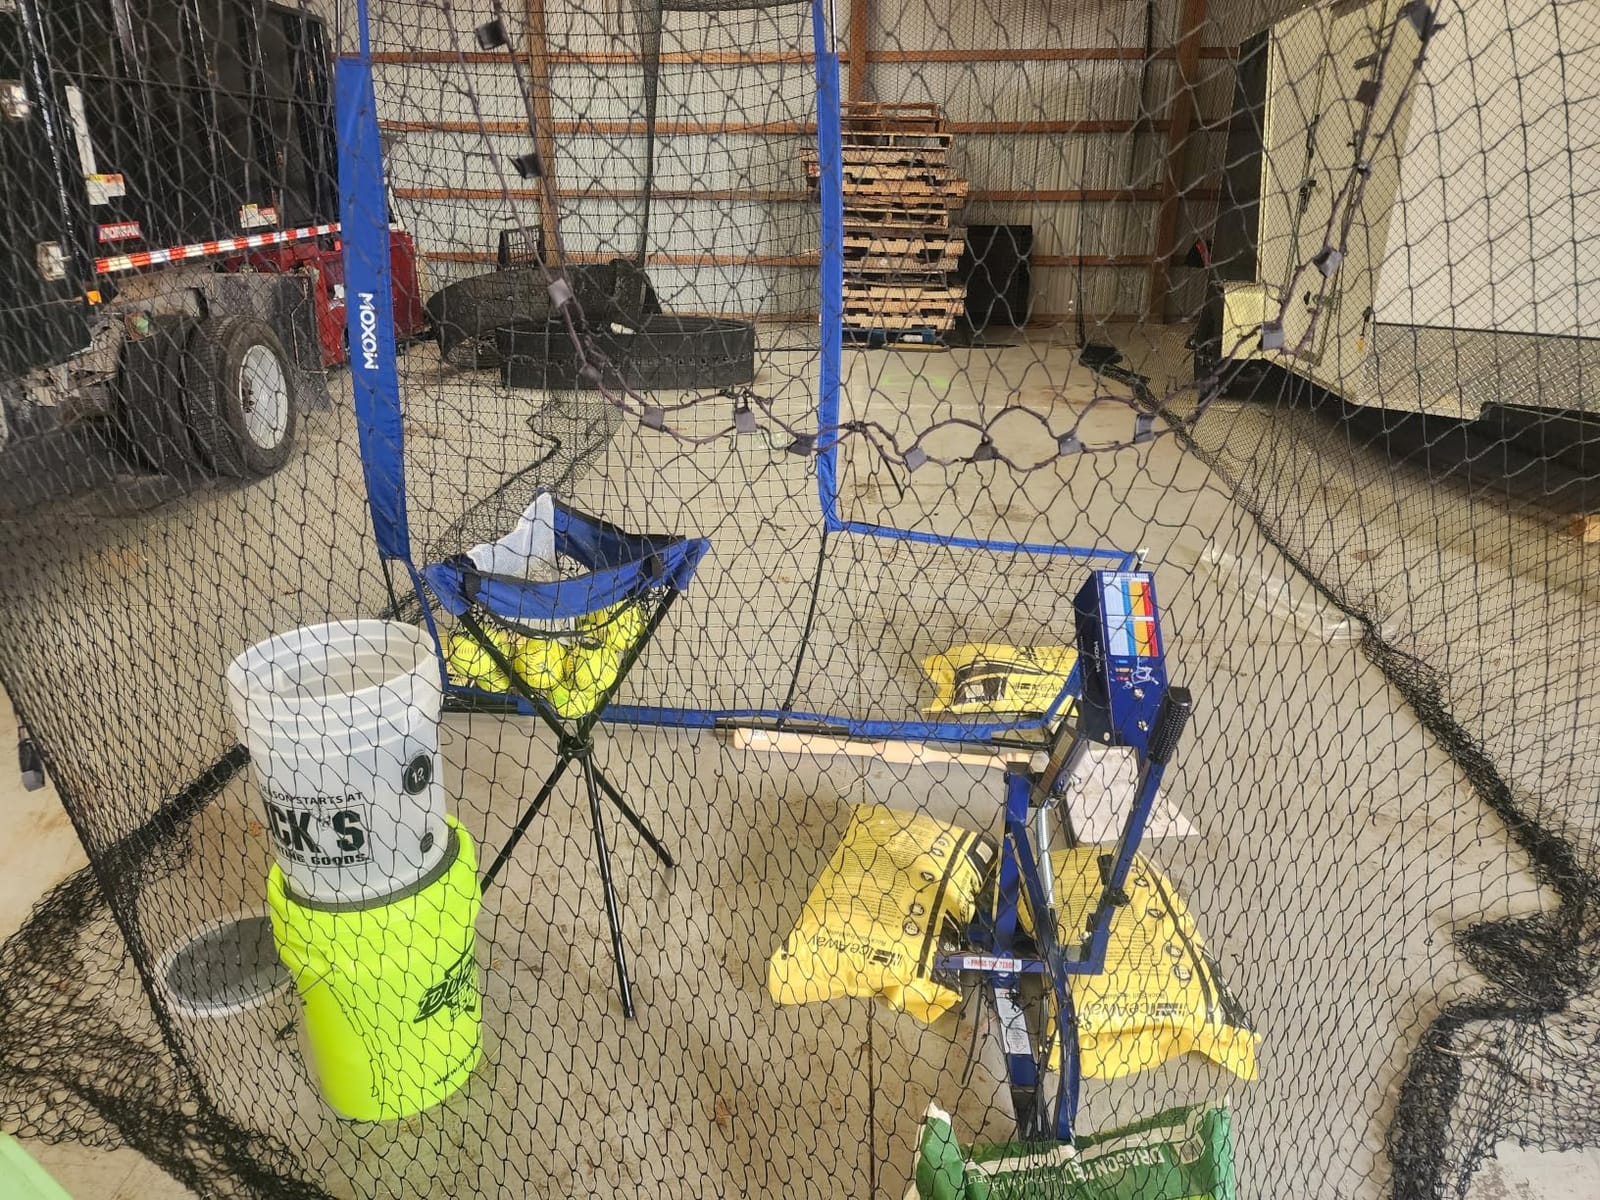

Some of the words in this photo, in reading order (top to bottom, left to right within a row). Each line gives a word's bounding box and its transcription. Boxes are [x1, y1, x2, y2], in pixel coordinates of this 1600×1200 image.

[296, 794, 344, 806] STARTS
[347, 791, 363, 802] AT
[311, 853, 367, 866] GOODS
[1096, 1147, 1165, 1177] DRAGON
